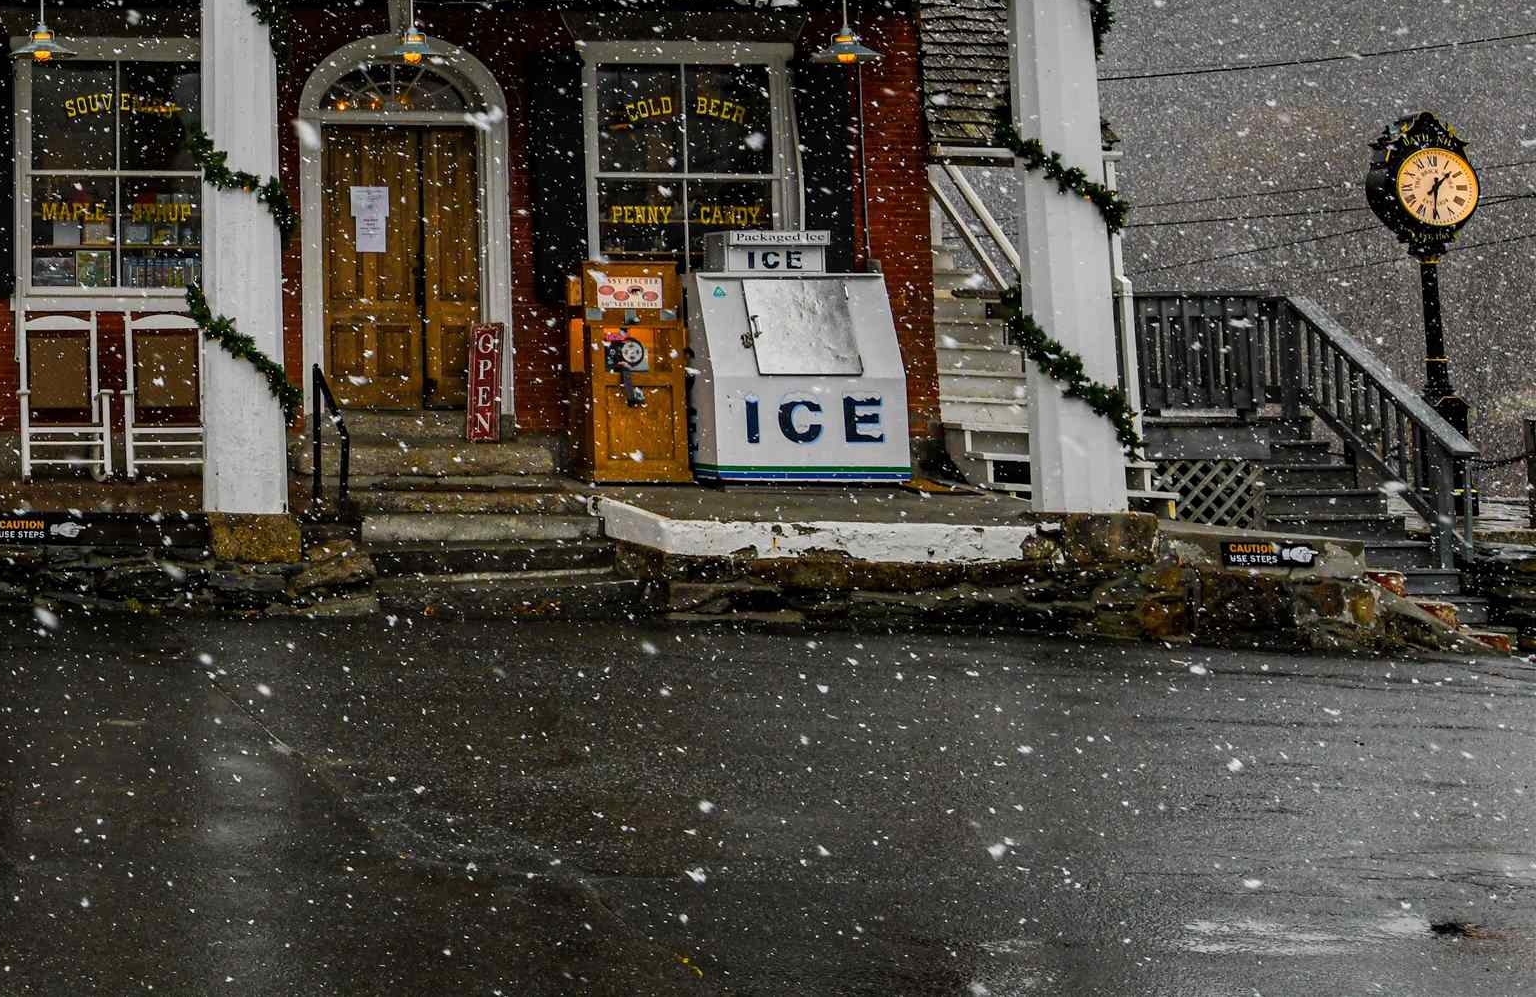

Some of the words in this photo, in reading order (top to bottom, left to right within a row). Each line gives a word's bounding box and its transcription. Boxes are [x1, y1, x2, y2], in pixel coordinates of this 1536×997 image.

[625, 96, 673, 122] COLD
[696, 96, 746, 124] BEER
[41, 203, 106, 220] MAPLE
[611, 206, 672, 224] PENNY
[700, 207, 761, 225] CANDY
[736, 233, 801, 244] Packaged
[805, 232, 825, 242] Ice
[748, 251, 802, 269] ICE
[475, 333, 496, 434] OPEN
[742, 391, 885, 444] ICE
[0, 520, 44, 529] CAUTION
[17, 530, 45, 538] STEPS
[1229, 544, 1277, 553] CAUTION
[1230, 554, 1248, 563] USE
[1249, 555, 1279, 563] STEPS
